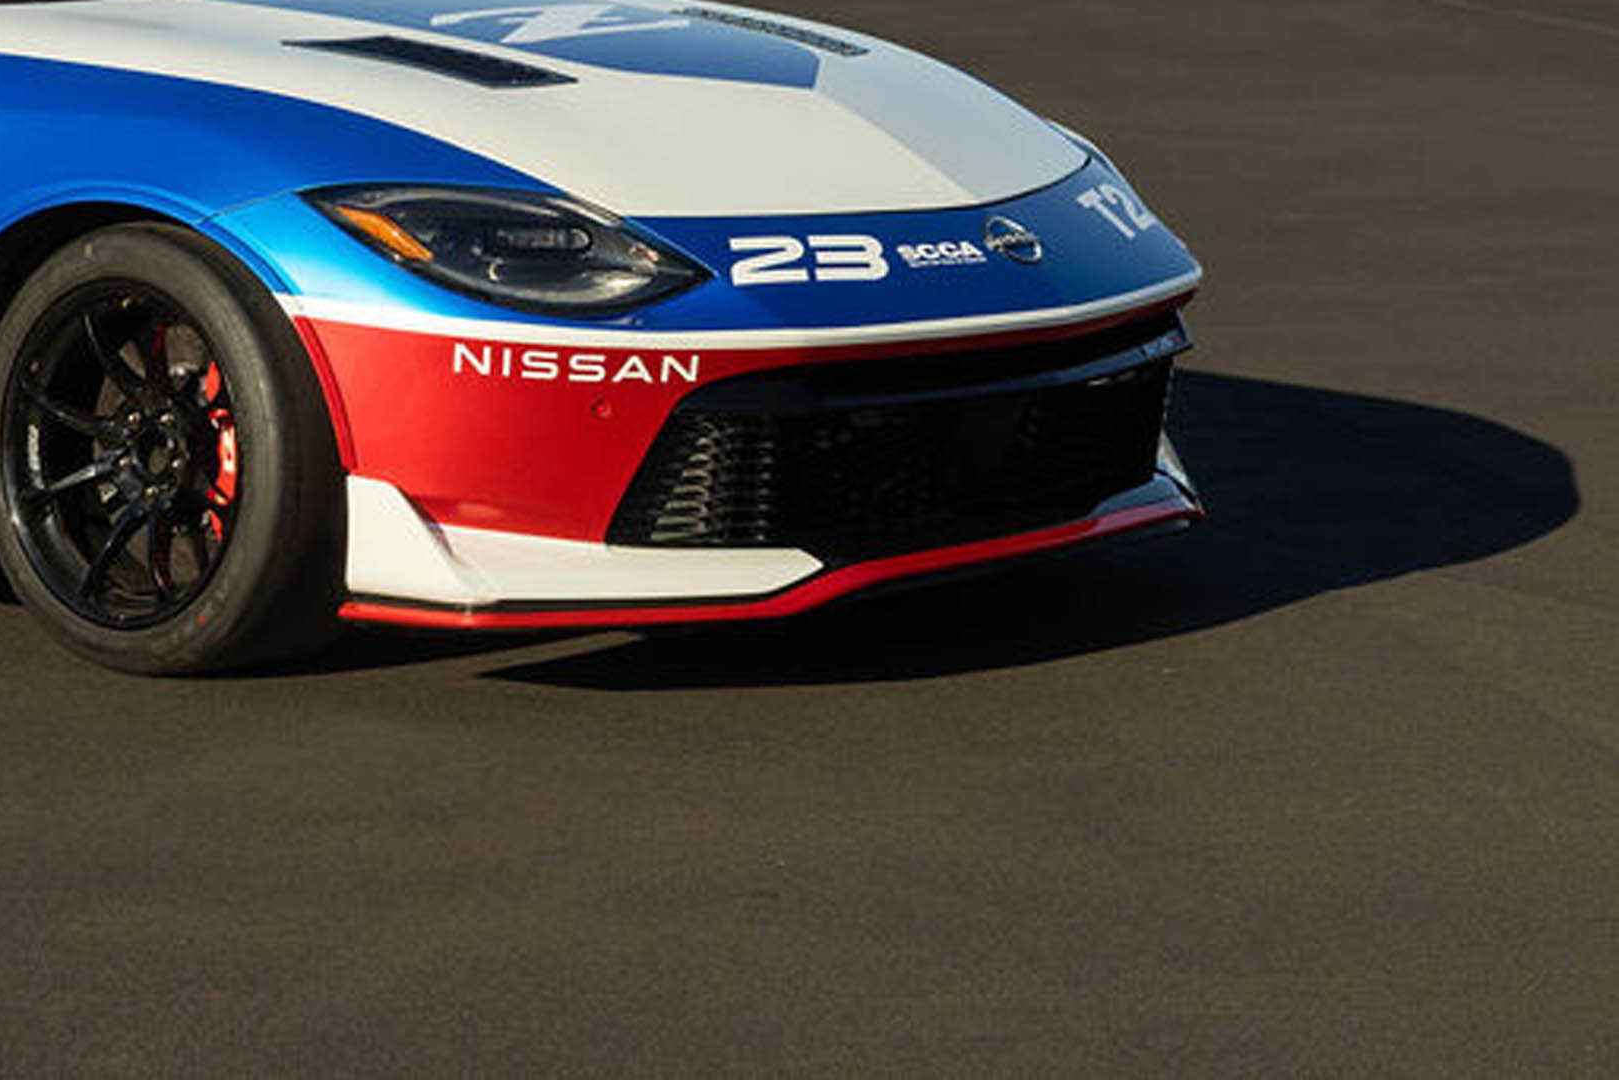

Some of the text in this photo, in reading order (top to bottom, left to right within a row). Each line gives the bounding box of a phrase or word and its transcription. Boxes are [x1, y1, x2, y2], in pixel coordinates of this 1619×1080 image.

[1076, 184, 1158, 240] T2
[728, 233, 891, 287] 23
[896, 240, 984, 261] SCCA
[453, 342, 700, 383] NISSAN
